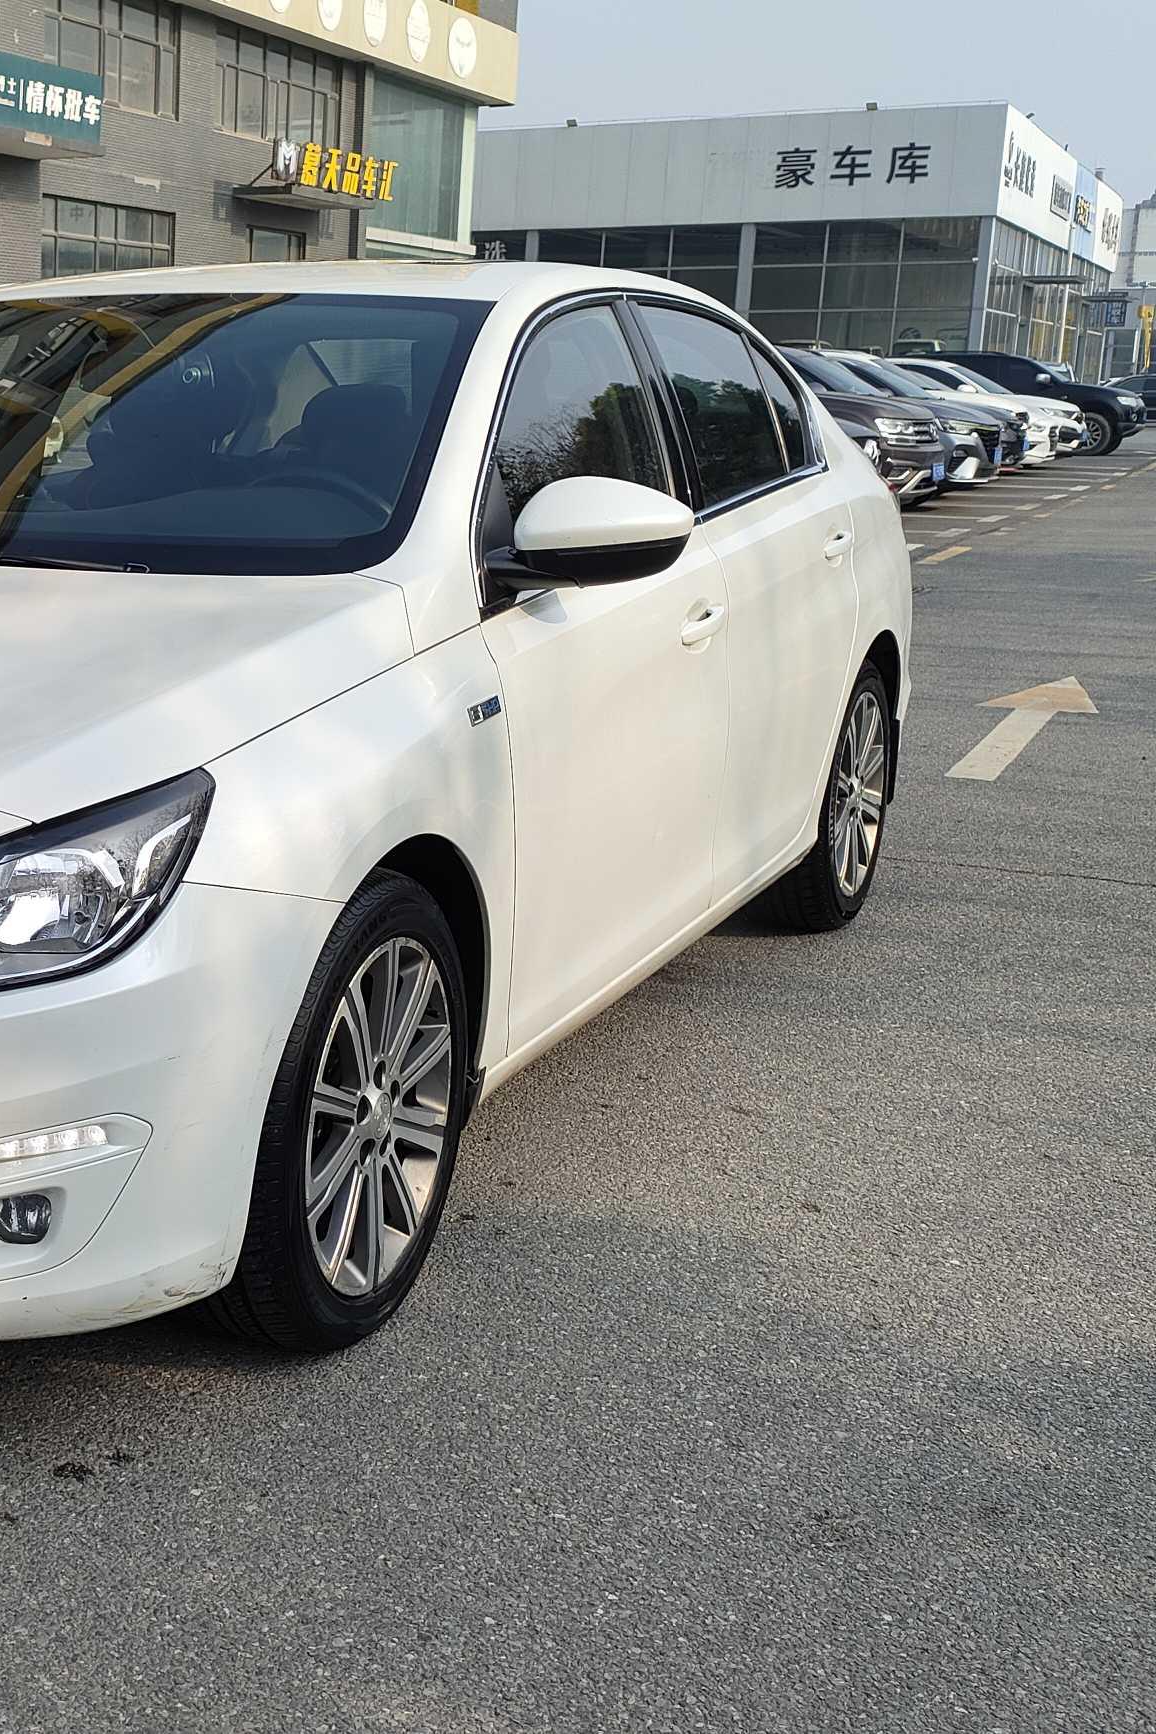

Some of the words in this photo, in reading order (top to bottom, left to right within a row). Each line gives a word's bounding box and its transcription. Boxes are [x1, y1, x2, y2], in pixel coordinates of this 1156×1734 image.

[25, 80, 101, 125] 情怀批车
[300, 142, 399, 201] 慕天品车汇
[774, 142, 932, 189] 豪车库
